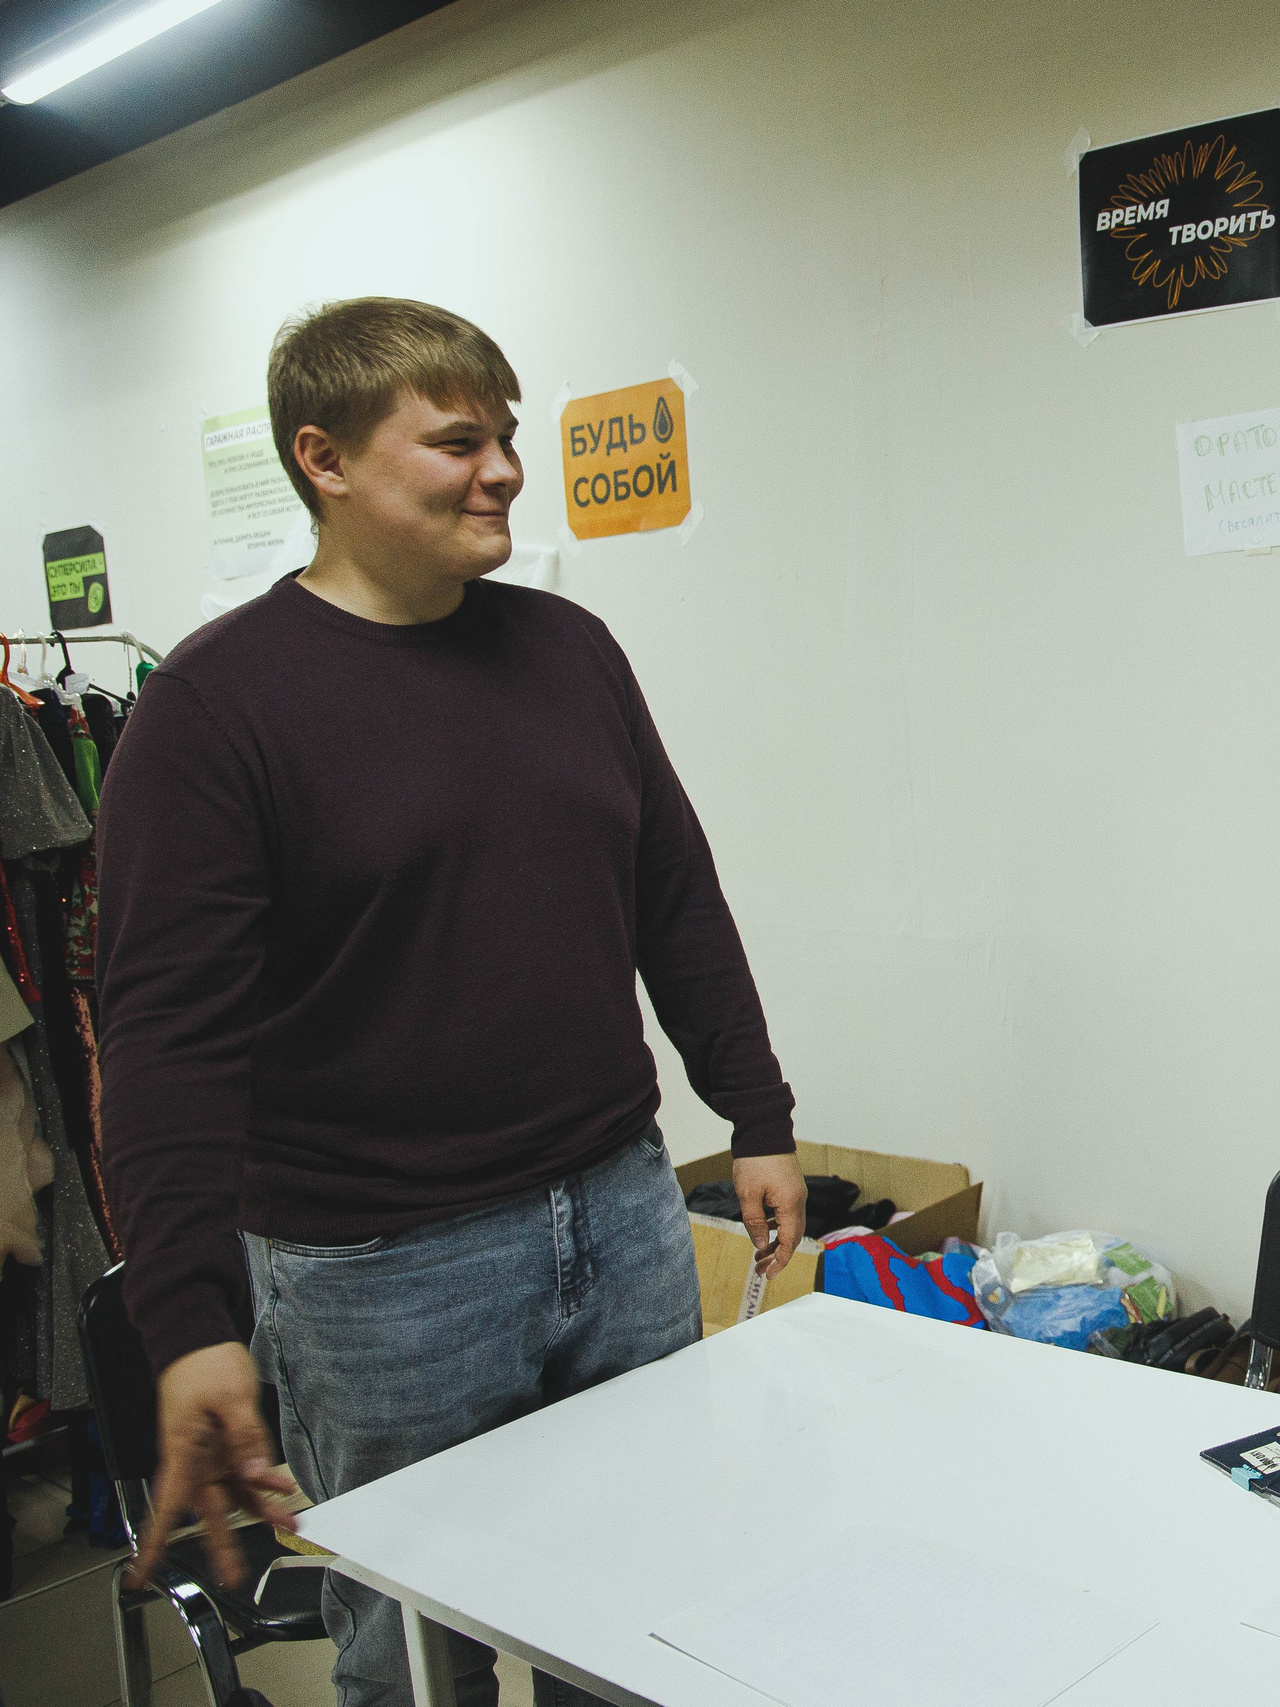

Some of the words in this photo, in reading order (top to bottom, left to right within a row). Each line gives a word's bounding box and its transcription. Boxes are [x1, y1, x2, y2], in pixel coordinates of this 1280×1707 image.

[1096, 198, 1170, 232] ВРЕМЯ
[1169, 209, 1276, 246] ТВОРИТЬ
[205, 428, 244, 448] ГАРАЖНАЯ
[246, 422, 271, 437] РАСПР
[570, 413, 647, 457] БУДЬ
[573, 452, 677, 508] СОБОЙ
